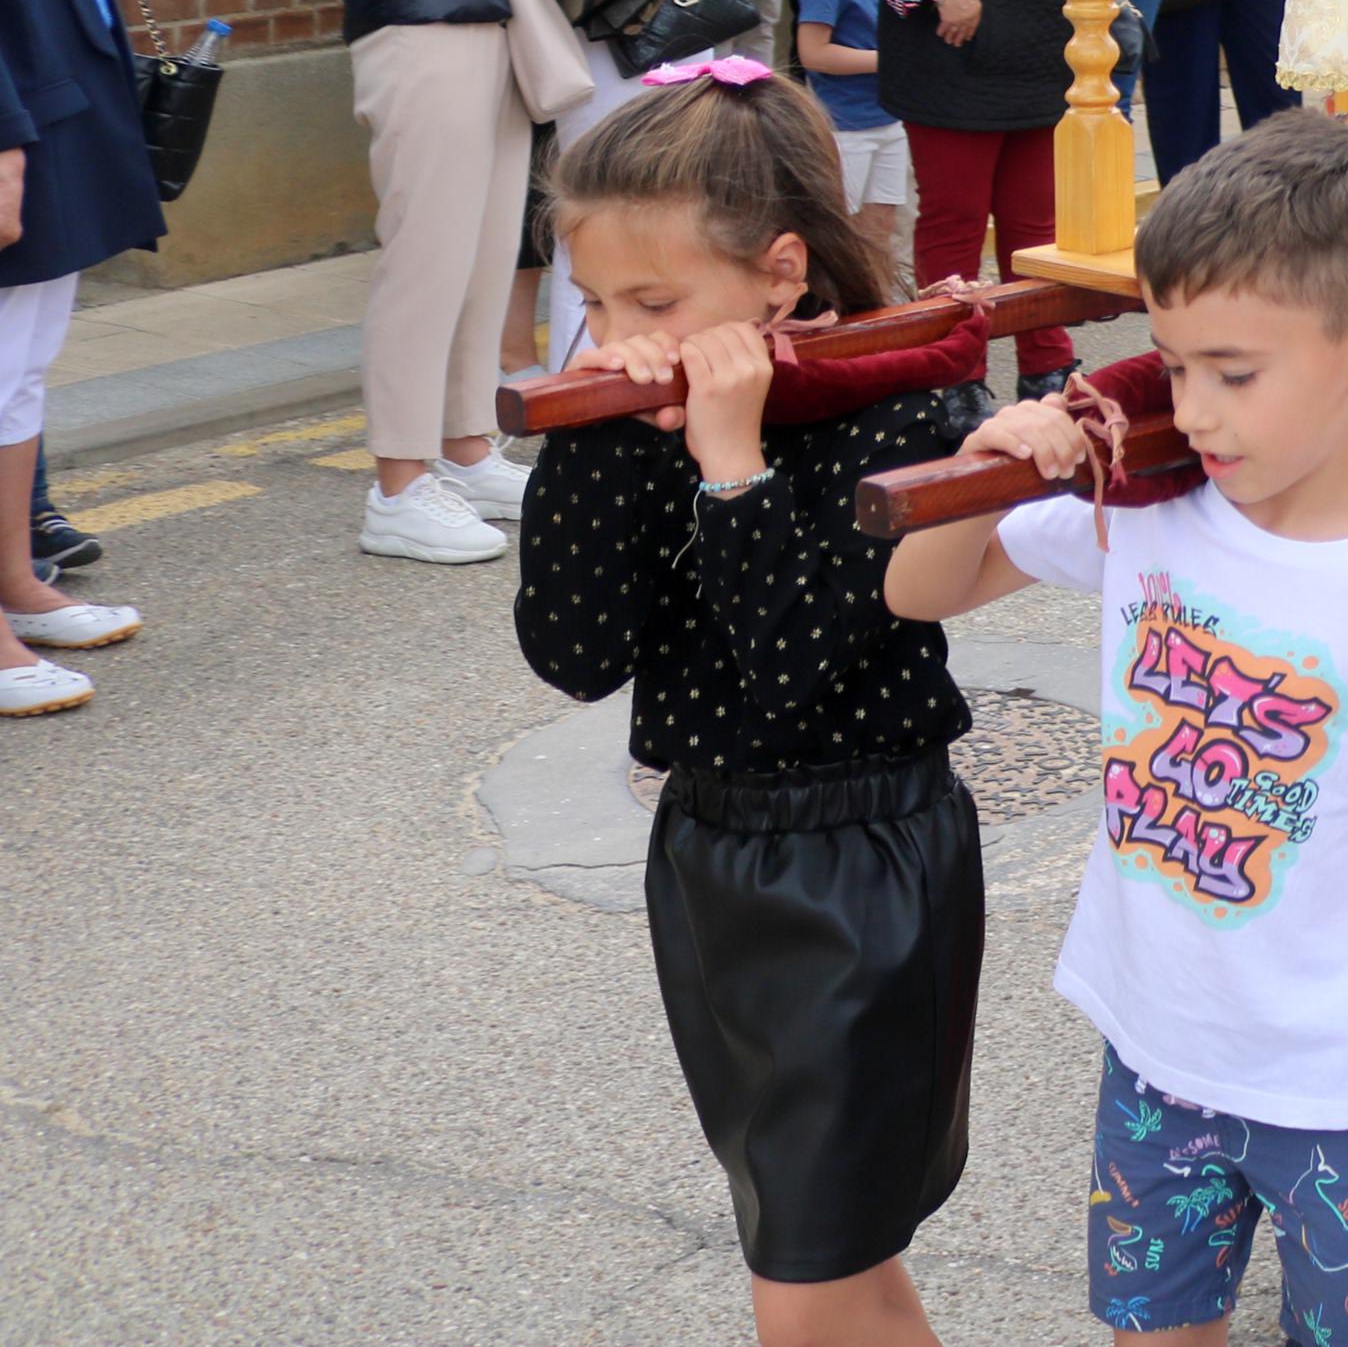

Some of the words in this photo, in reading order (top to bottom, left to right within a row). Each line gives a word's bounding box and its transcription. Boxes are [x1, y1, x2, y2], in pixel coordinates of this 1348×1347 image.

[1120, 600, 1158, 627] LESS
[1161, 602, 1220, 638] RULES
[1128, 626, 1334, 763] LET'S
[1149, 718, 1248, 812] GO
[1103, 759, 1268, 903] PLAY
[1225, 778, 1318, 843] TIMES
[1144, 1238, 1165, 1271] SUN
